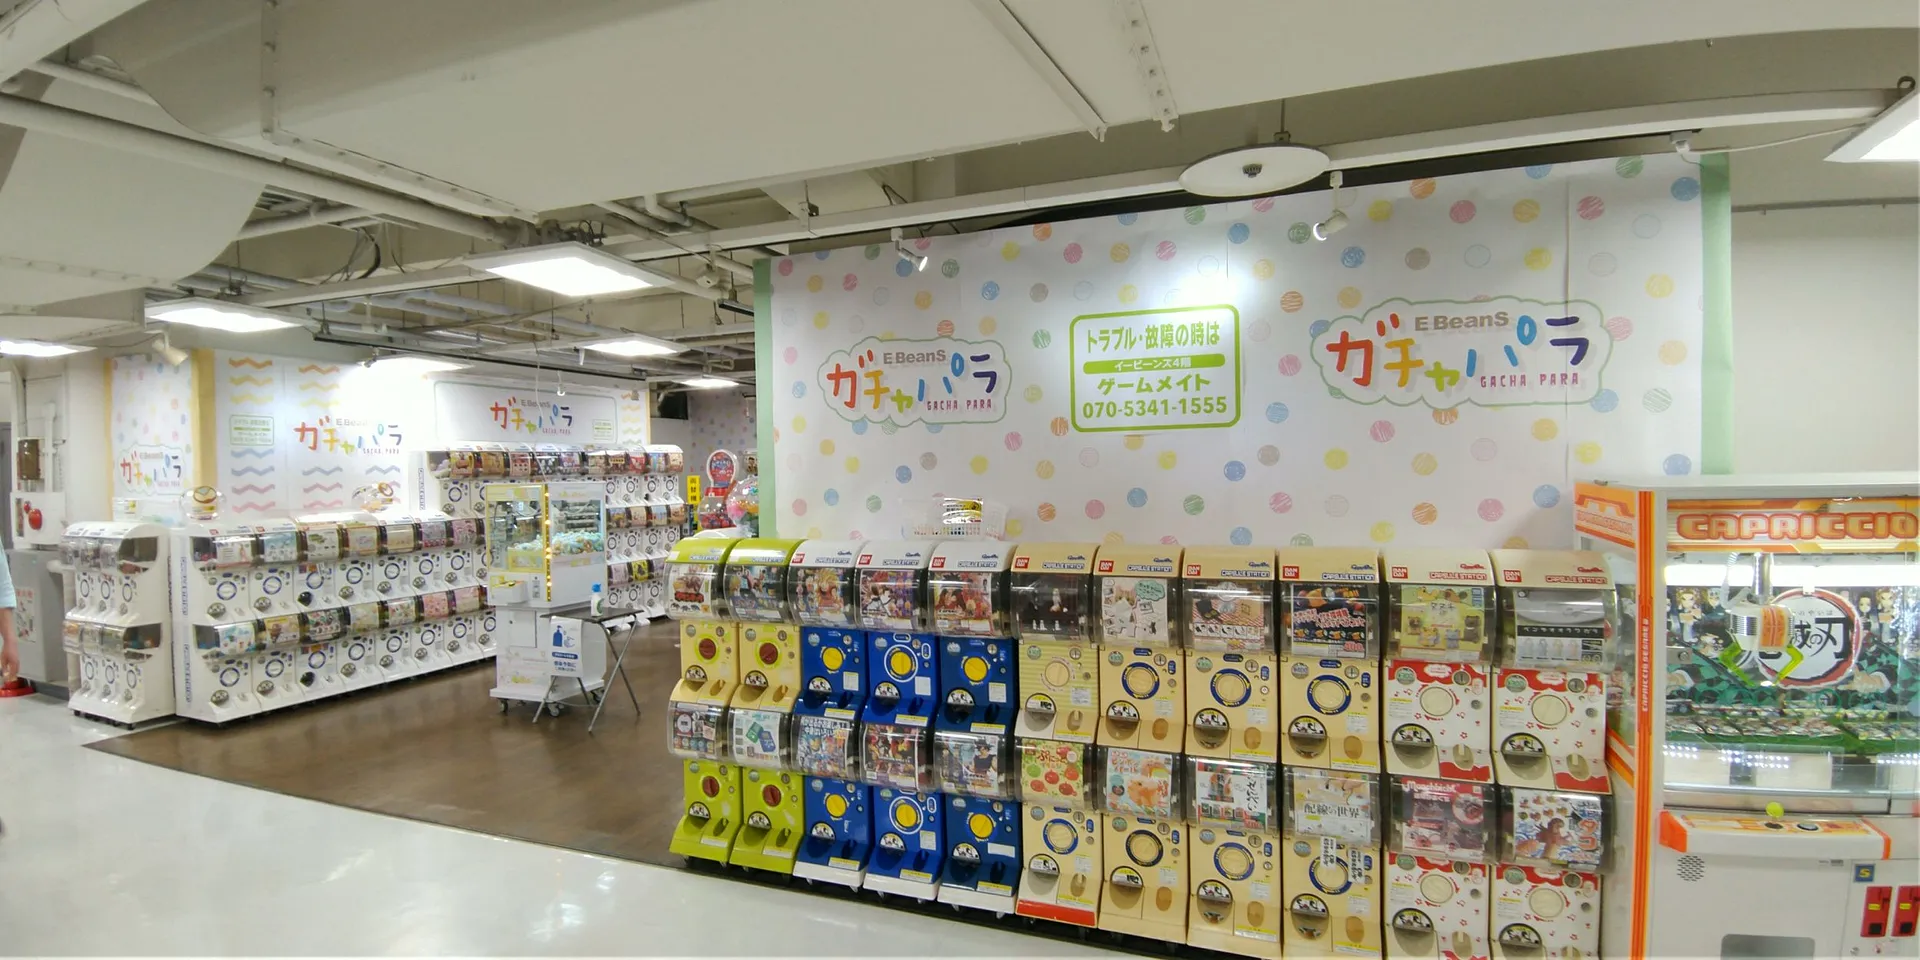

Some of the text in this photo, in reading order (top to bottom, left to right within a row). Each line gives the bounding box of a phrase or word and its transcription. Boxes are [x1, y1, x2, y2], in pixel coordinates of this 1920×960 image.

[1414, 311, 1509, 332] E BeanS
[1087, 321, 1220, 353] トラブル・故障の時は
[883, 349, 947, 365] E BeanS
[1326, 313, 1589, 392] ガチャパラ
[826, 349, 998, 414] ガチャパラ
[1097, 373, 1211, 396] ゲームメイト
[1480, 372, 1579, 388] GACHA PARA
[489, 396, 573, 434] ガチャパラ
[926, 398, 992, 411] GACHA PARA
[1082, 396, 1228, 419] 070-5341-1555
[293, 415, 402, 455] ガチャパラ
[120, 450, 181, 486] ガチャパラ
[1676, 511, 1918, 540] CAPRICCIO
